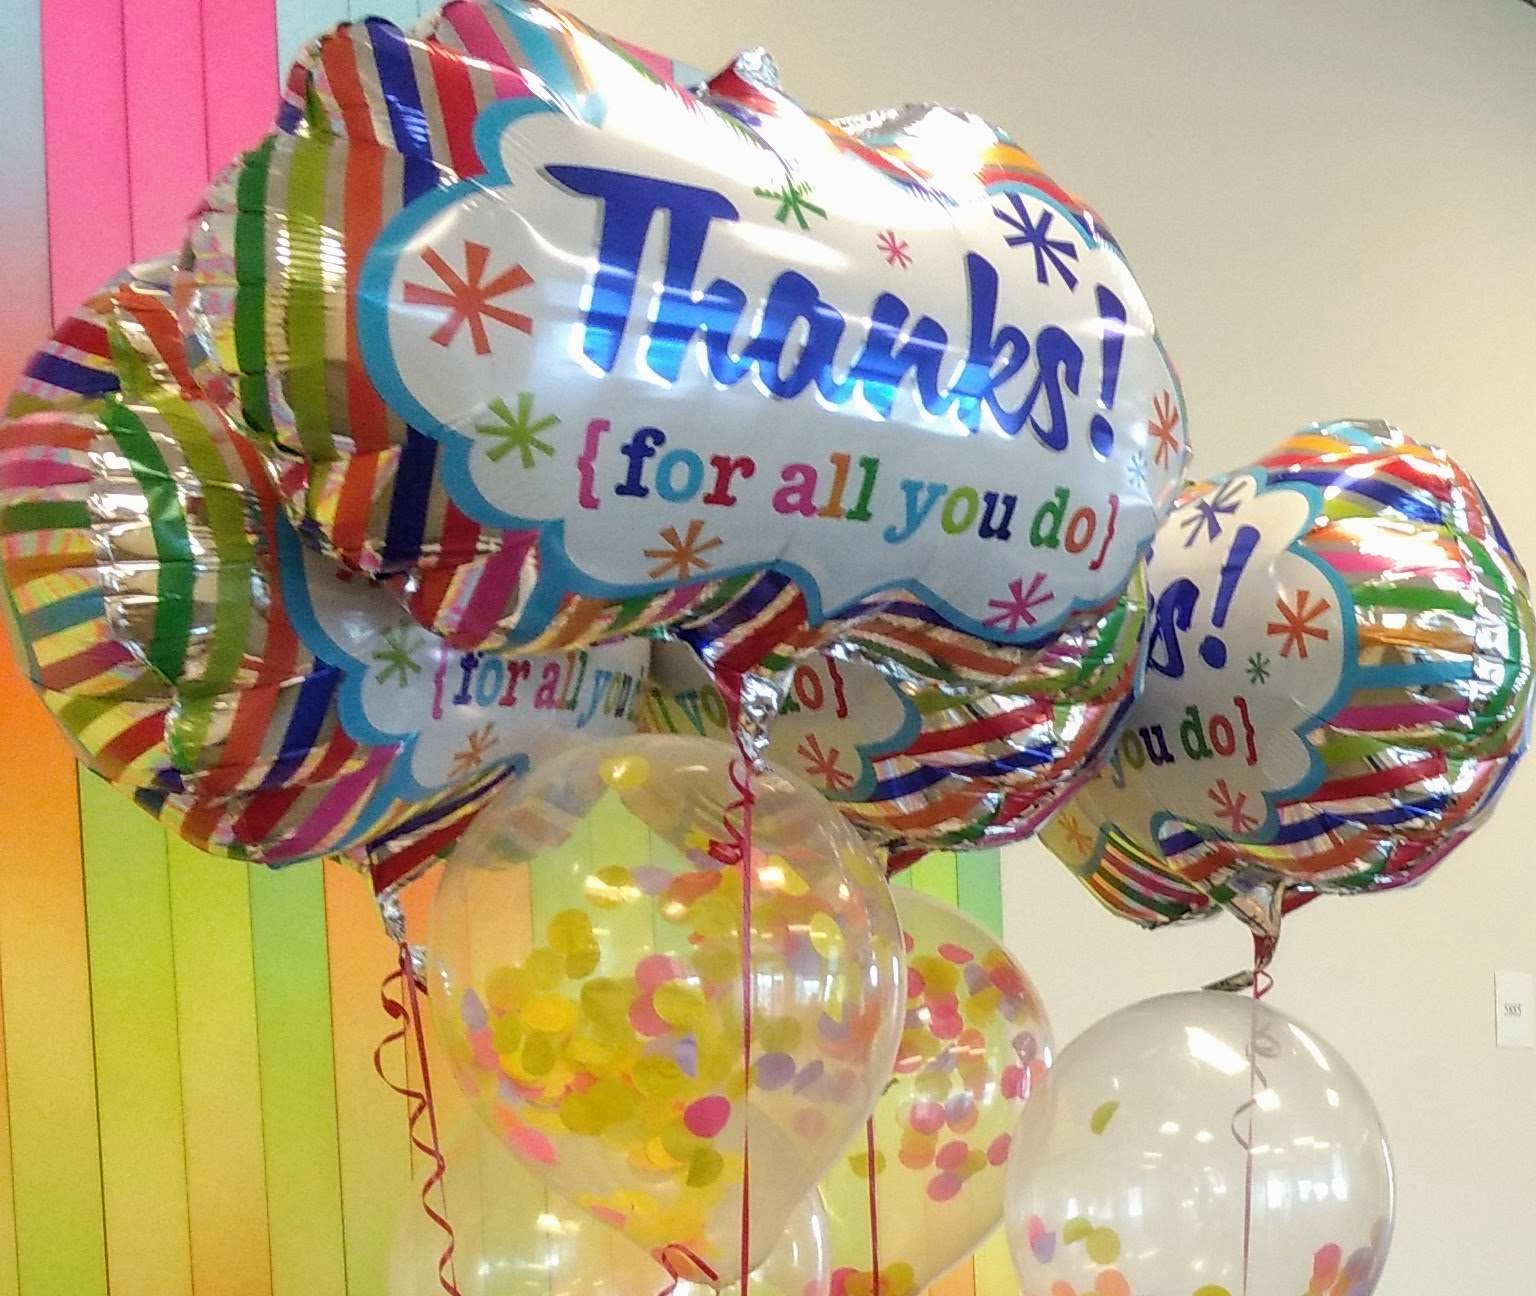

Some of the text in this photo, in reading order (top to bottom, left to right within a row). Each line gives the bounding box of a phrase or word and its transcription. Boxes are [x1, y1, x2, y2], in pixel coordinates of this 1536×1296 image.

[537, 163, 1128, 463] Thanks!
[772, 451, 881, 525] all
[883, 475, 1018, 545] you
[1179, 694, 1258, 767] do}
